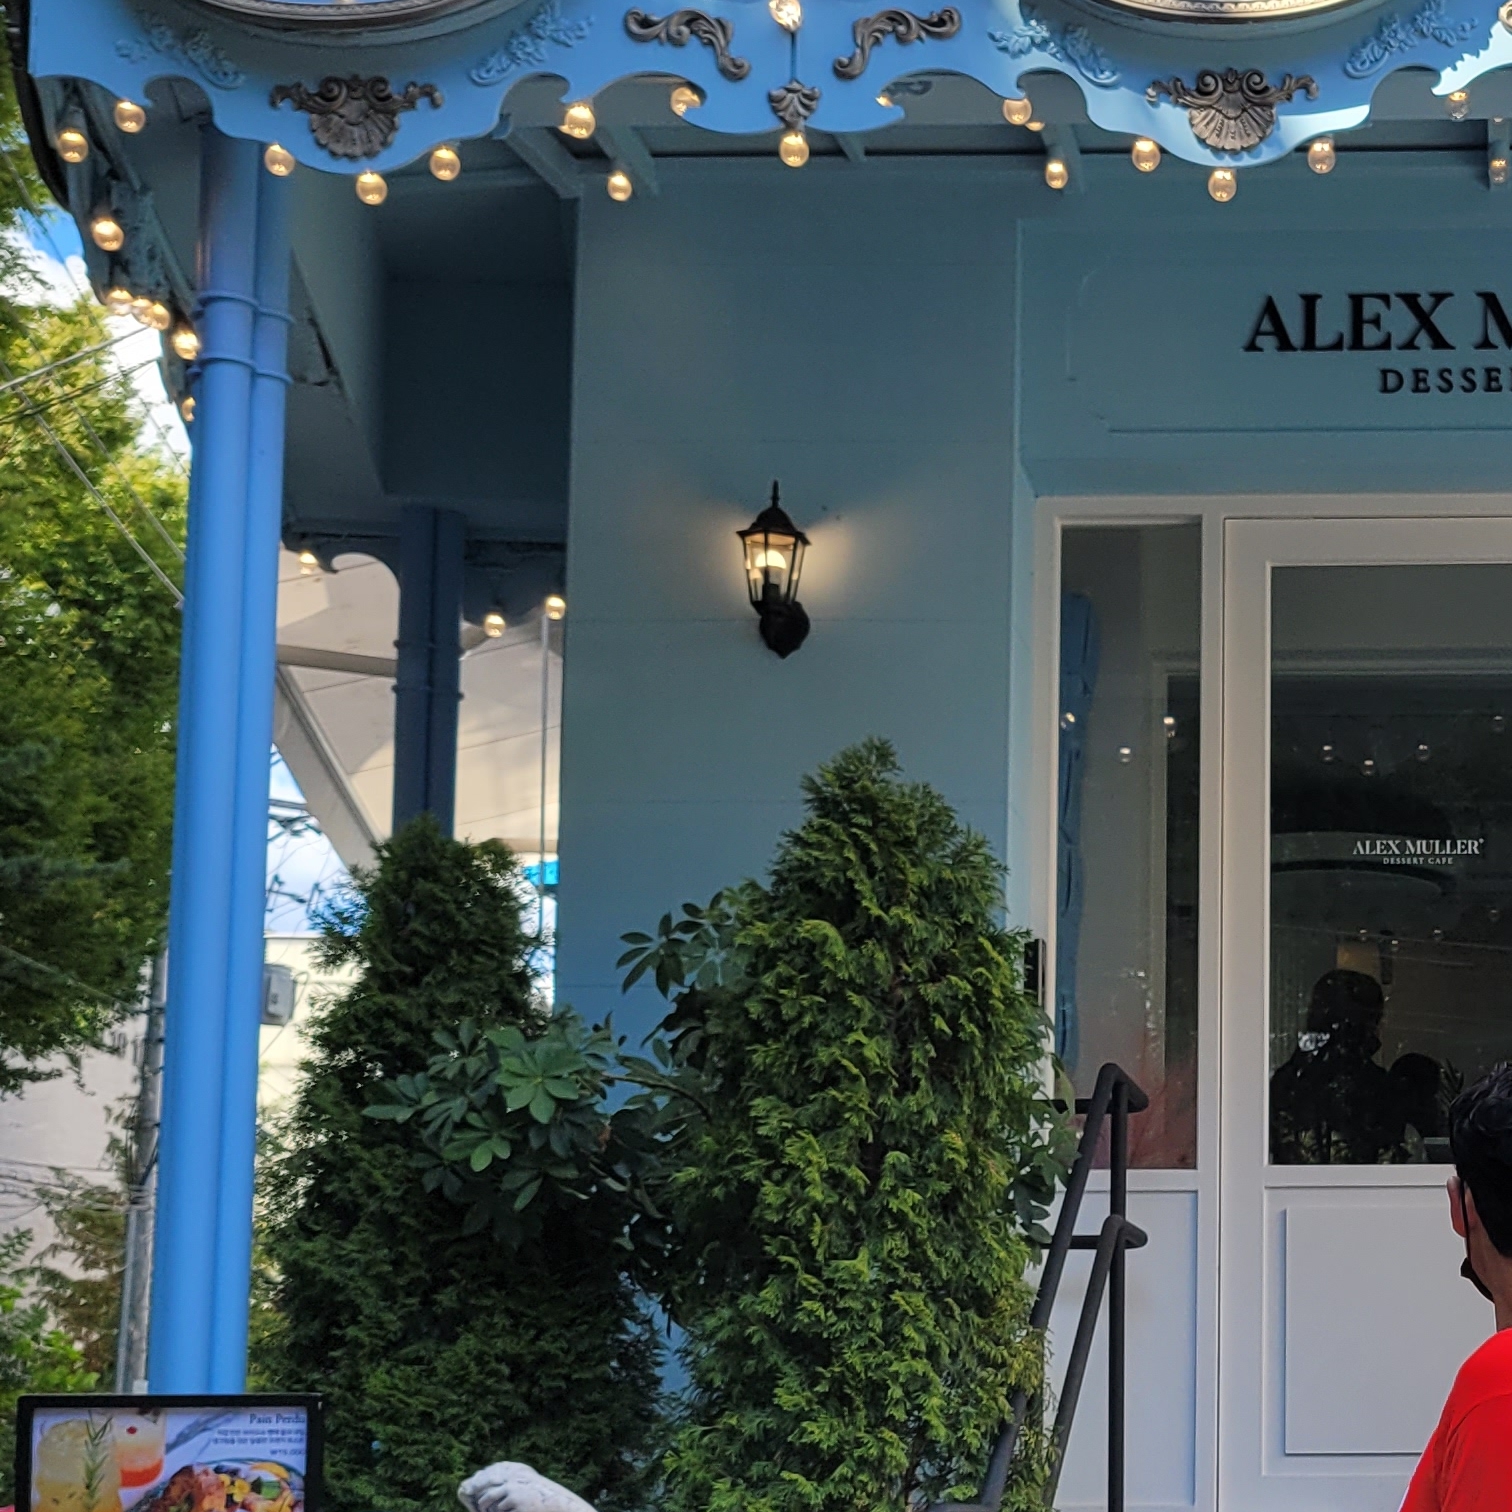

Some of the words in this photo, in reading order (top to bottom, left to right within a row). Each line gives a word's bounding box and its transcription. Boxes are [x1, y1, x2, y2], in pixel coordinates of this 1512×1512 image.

[1243, 290, 1457, 352] ALEX
[1353, 840, 1401, 855] ALEX
[1404, 839, 1480, 855] MULLER
[1383, 857, 1424, 865] DESSERT
[1428, 857, 1454, 865] CAFE
